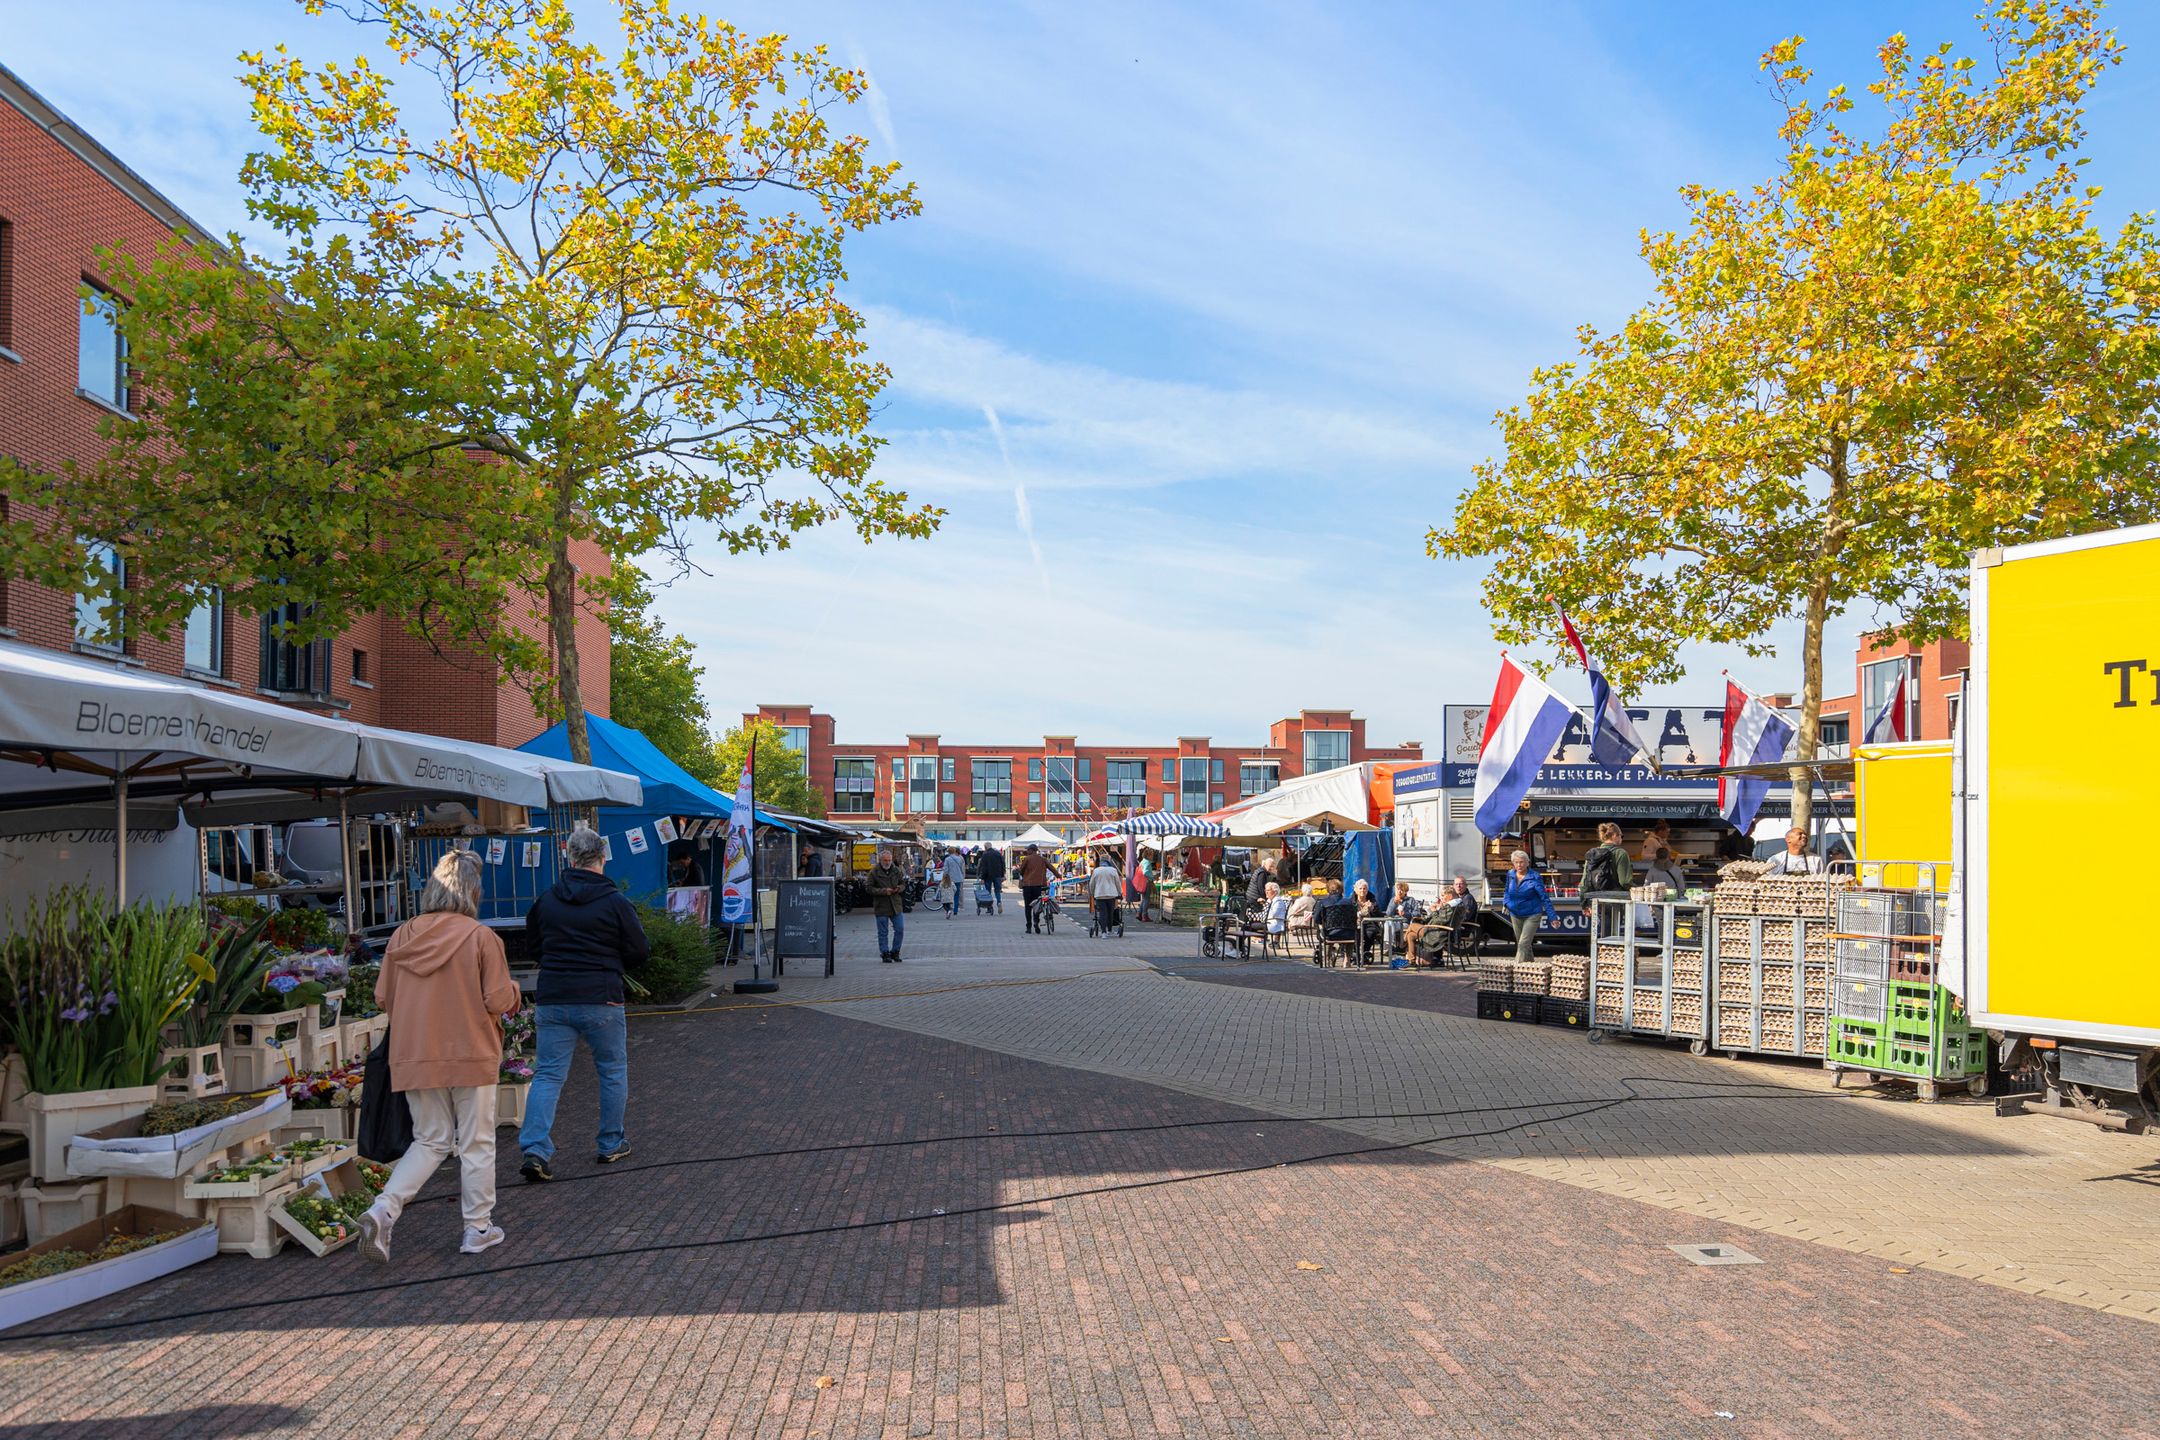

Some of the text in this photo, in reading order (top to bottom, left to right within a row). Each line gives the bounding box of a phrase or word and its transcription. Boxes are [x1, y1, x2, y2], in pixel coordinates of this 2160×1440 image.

[76, 701, 272, 753] Bloemenhandel
[415, 757, 508, 793] Bloemenhandel
[1550, 769, 1631, 780] LEKKERSTE
[1774, 806, 1791, 814] PATA
[1813, 806, 1828, 814] KER
